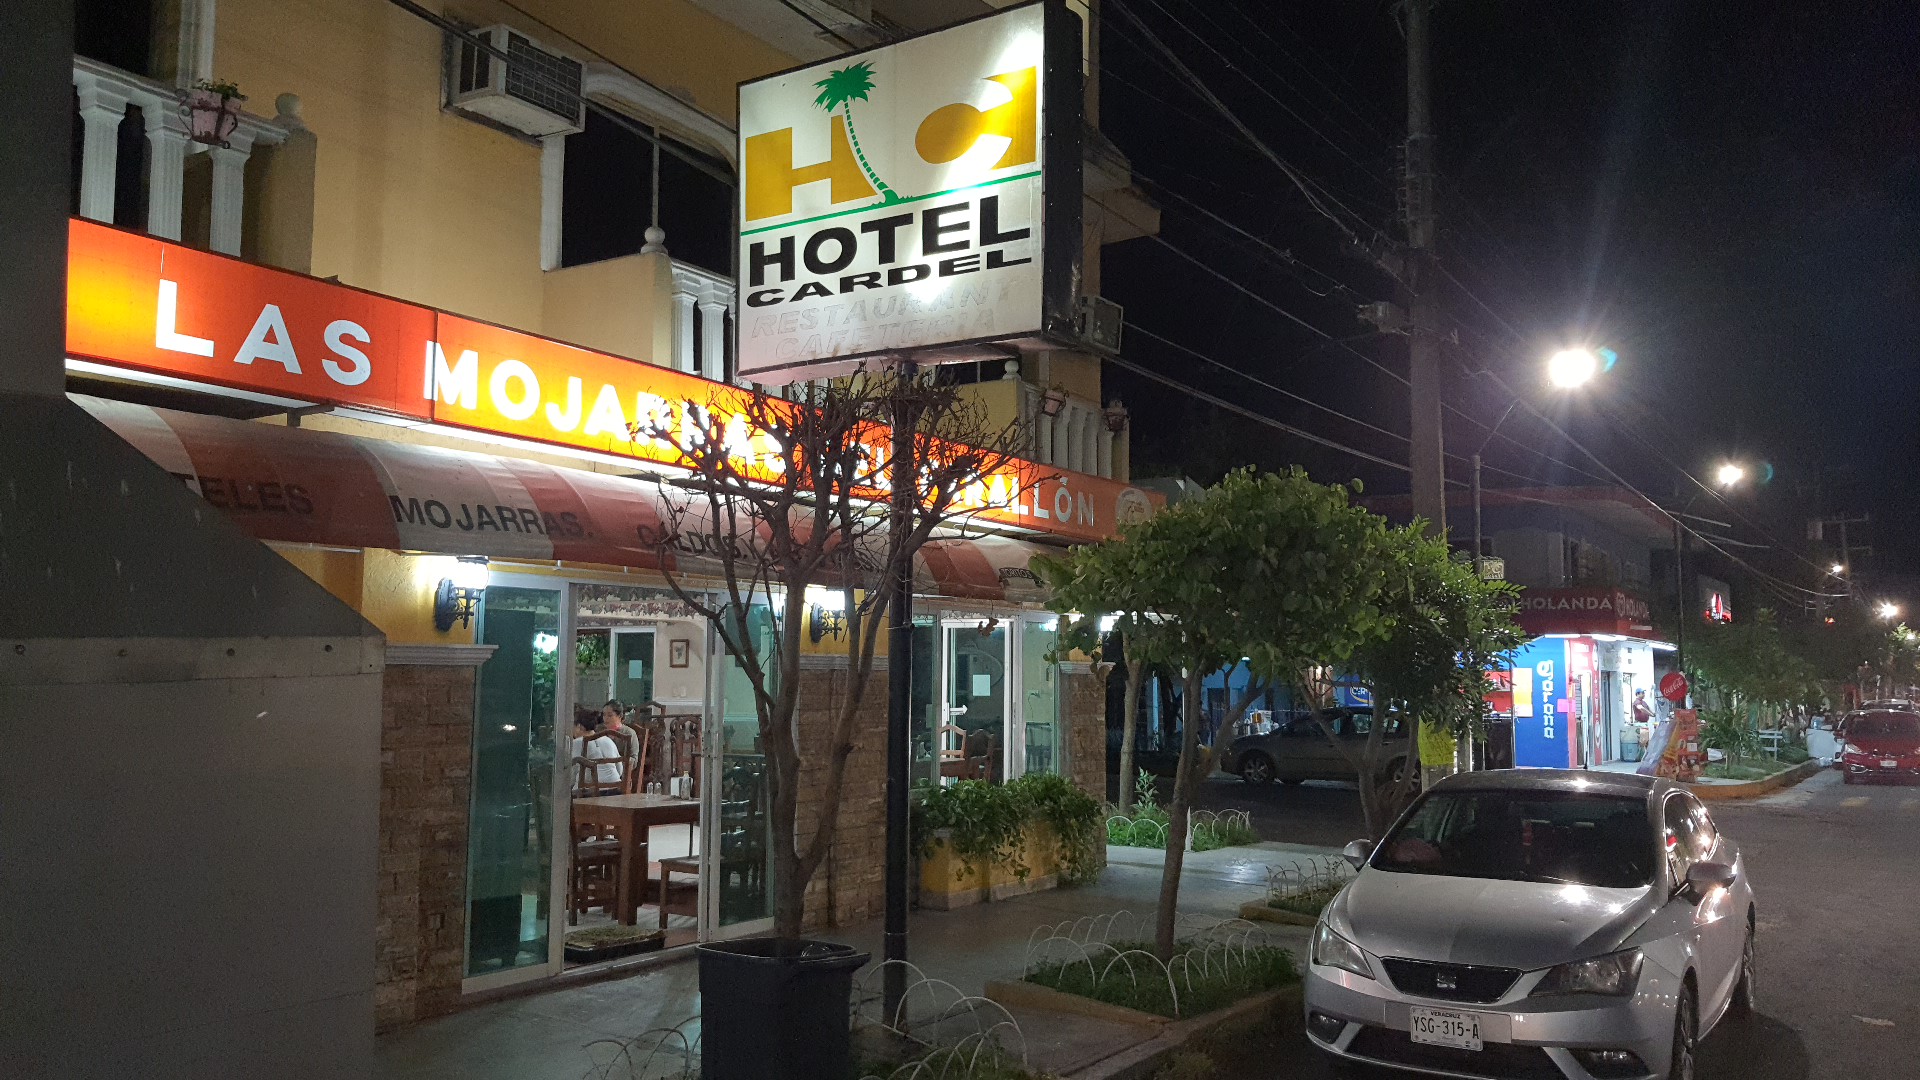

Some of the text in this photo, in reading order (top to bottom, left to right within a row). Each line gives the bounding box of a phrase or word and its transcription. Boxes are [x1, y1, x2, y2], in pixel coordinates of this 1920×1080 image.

[749, 195, 1031, 287] HOTEL
[746, 250, 1032, 308] CARDEL
[155, 278, 372, 387] LAS
[1521, 597, 1613, 610] HOLANDA
[1413, 1016, 1480, 1040] YSG-315-A
[1430, 1011, 1461, 1019] VERACRUZ
